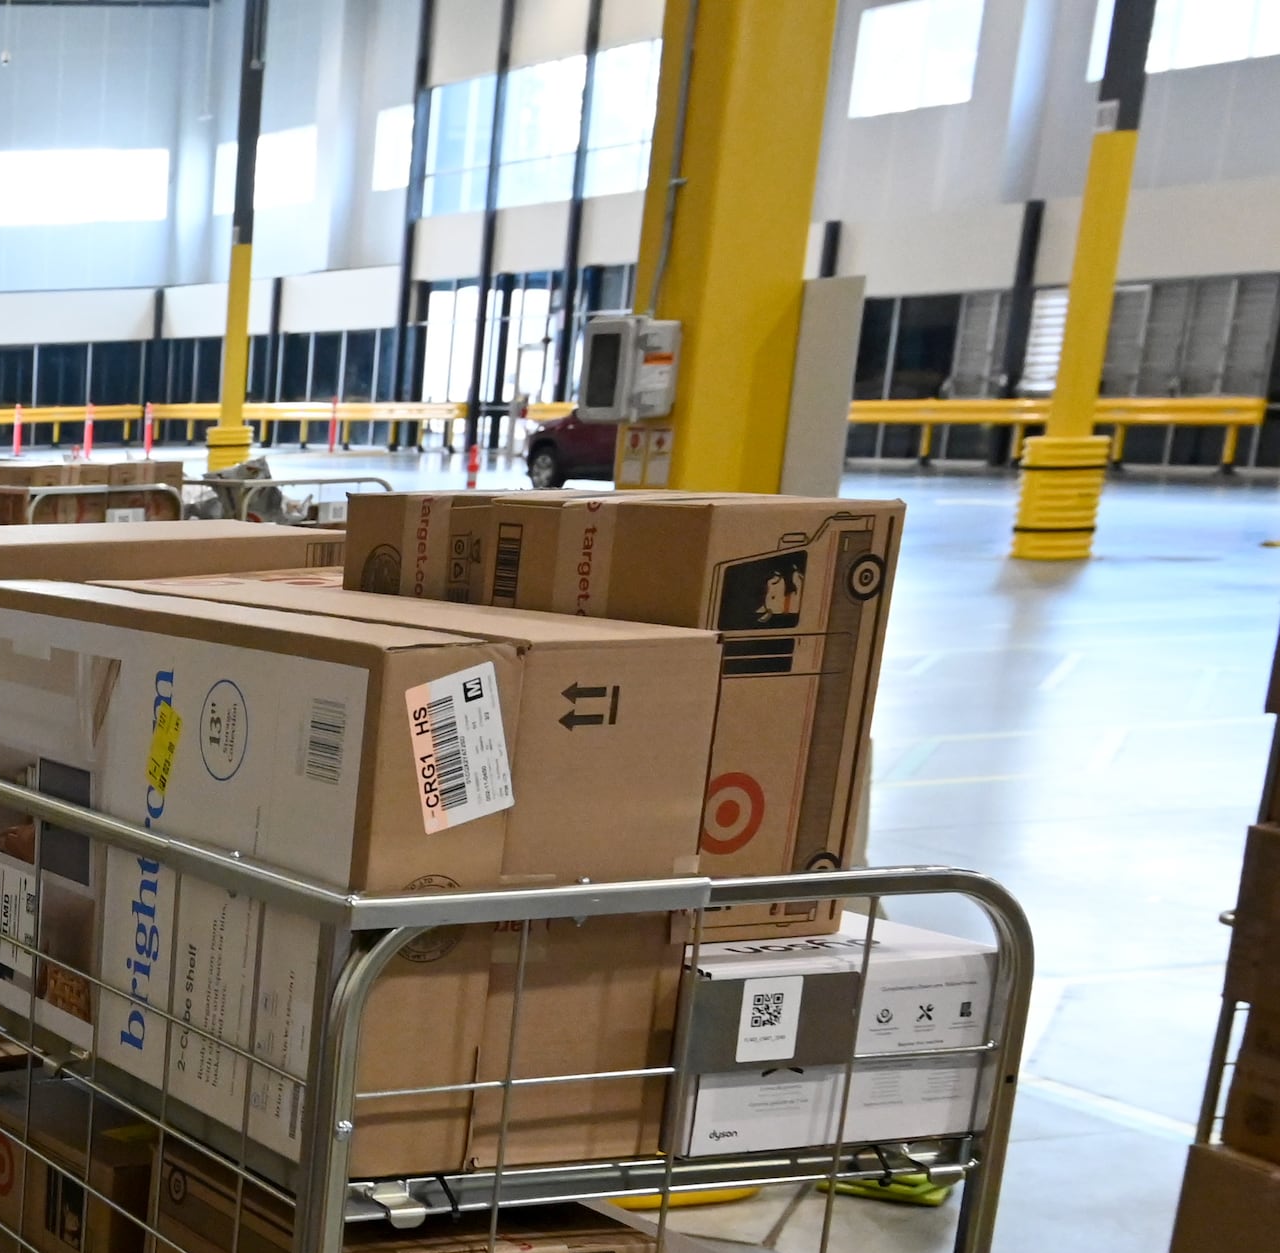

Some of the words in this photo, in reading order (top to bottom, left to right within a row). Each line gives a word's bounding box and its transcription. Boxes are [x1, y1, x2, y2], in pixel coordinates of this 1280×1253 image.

[413, 706, 430, 736] HS
[120, 668, 174, 1051] brightom
[186, 943, 198, 993] Shelf
[708, 1129, 738, 1141] dyson
